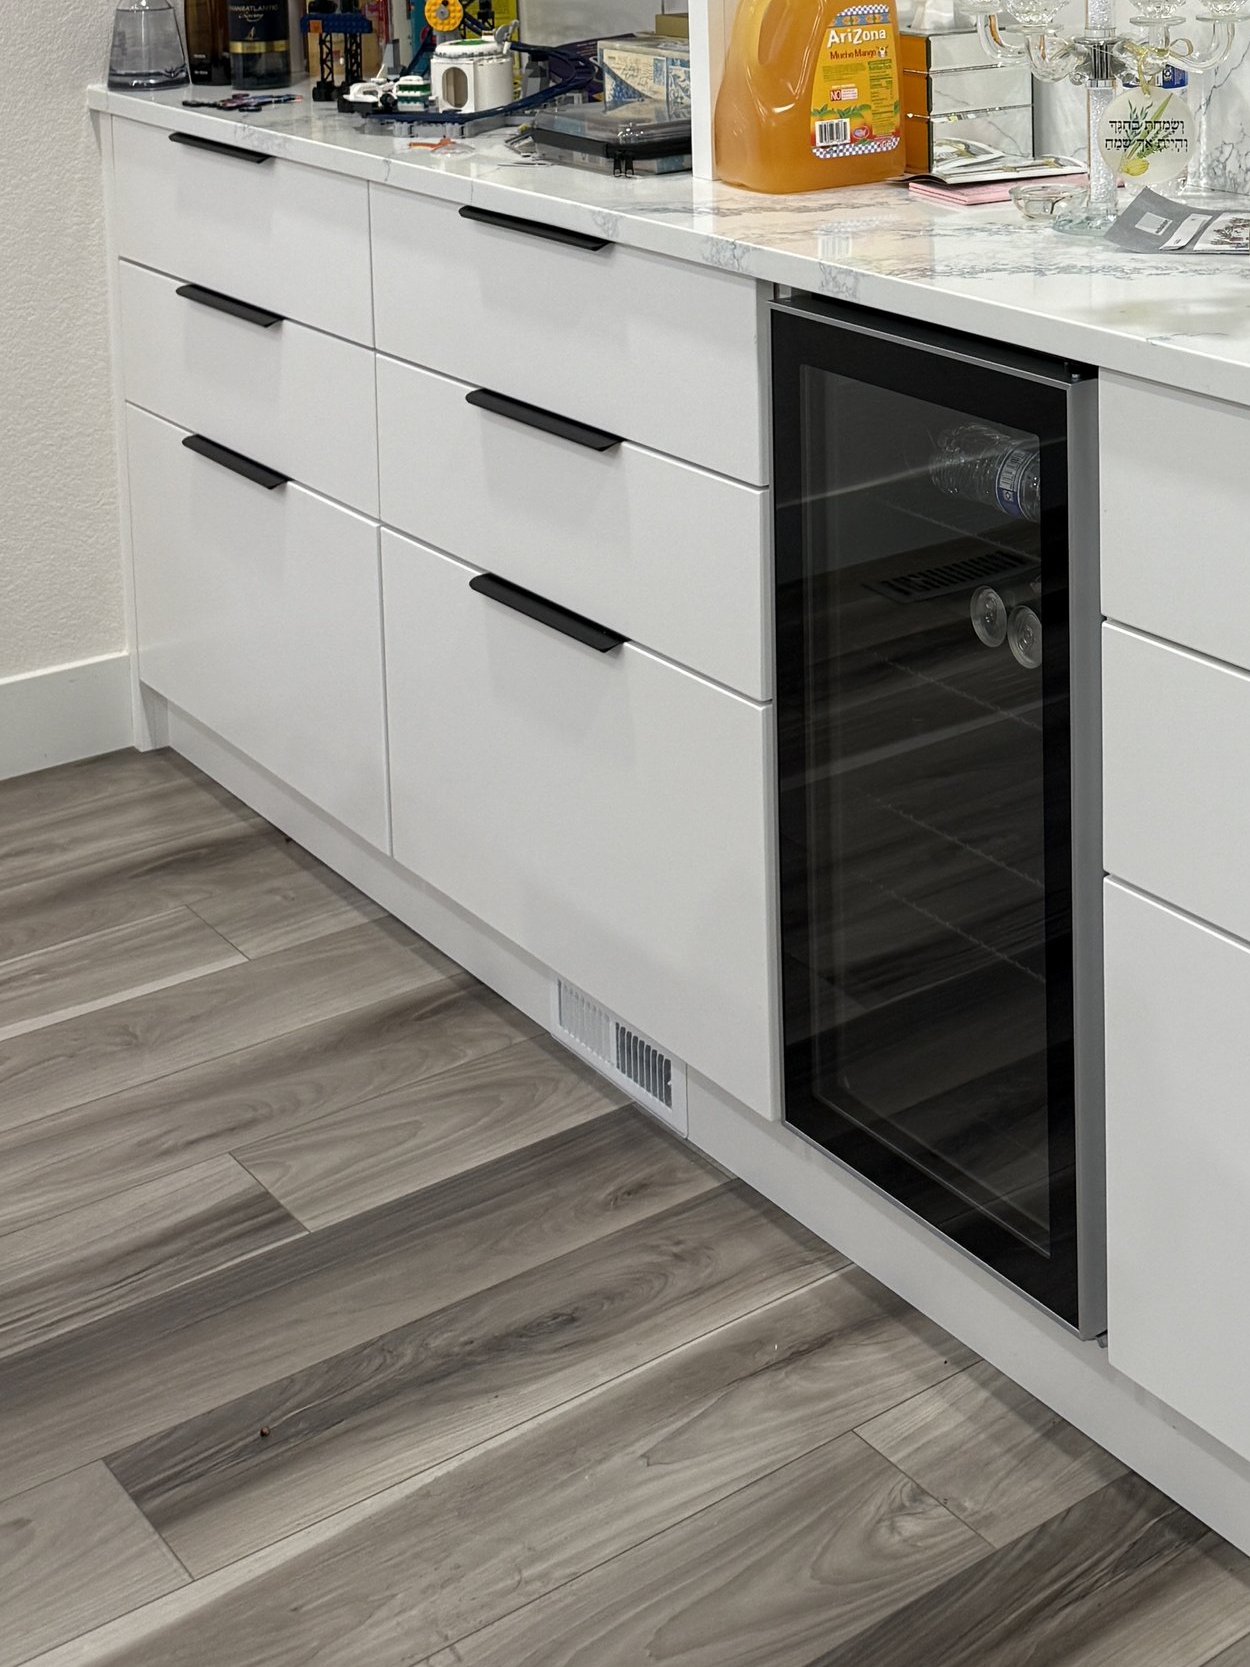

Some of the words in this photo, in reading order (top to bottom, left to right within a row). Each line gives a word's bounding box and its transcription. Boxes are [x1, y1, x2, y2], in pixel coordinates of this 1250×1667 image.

[827, 28, 886, 48] AriZona
[830, 50, 854, 60] Mucho
[855, 48, 877, 58] Mango
[831, 90, 841, 101] NO
